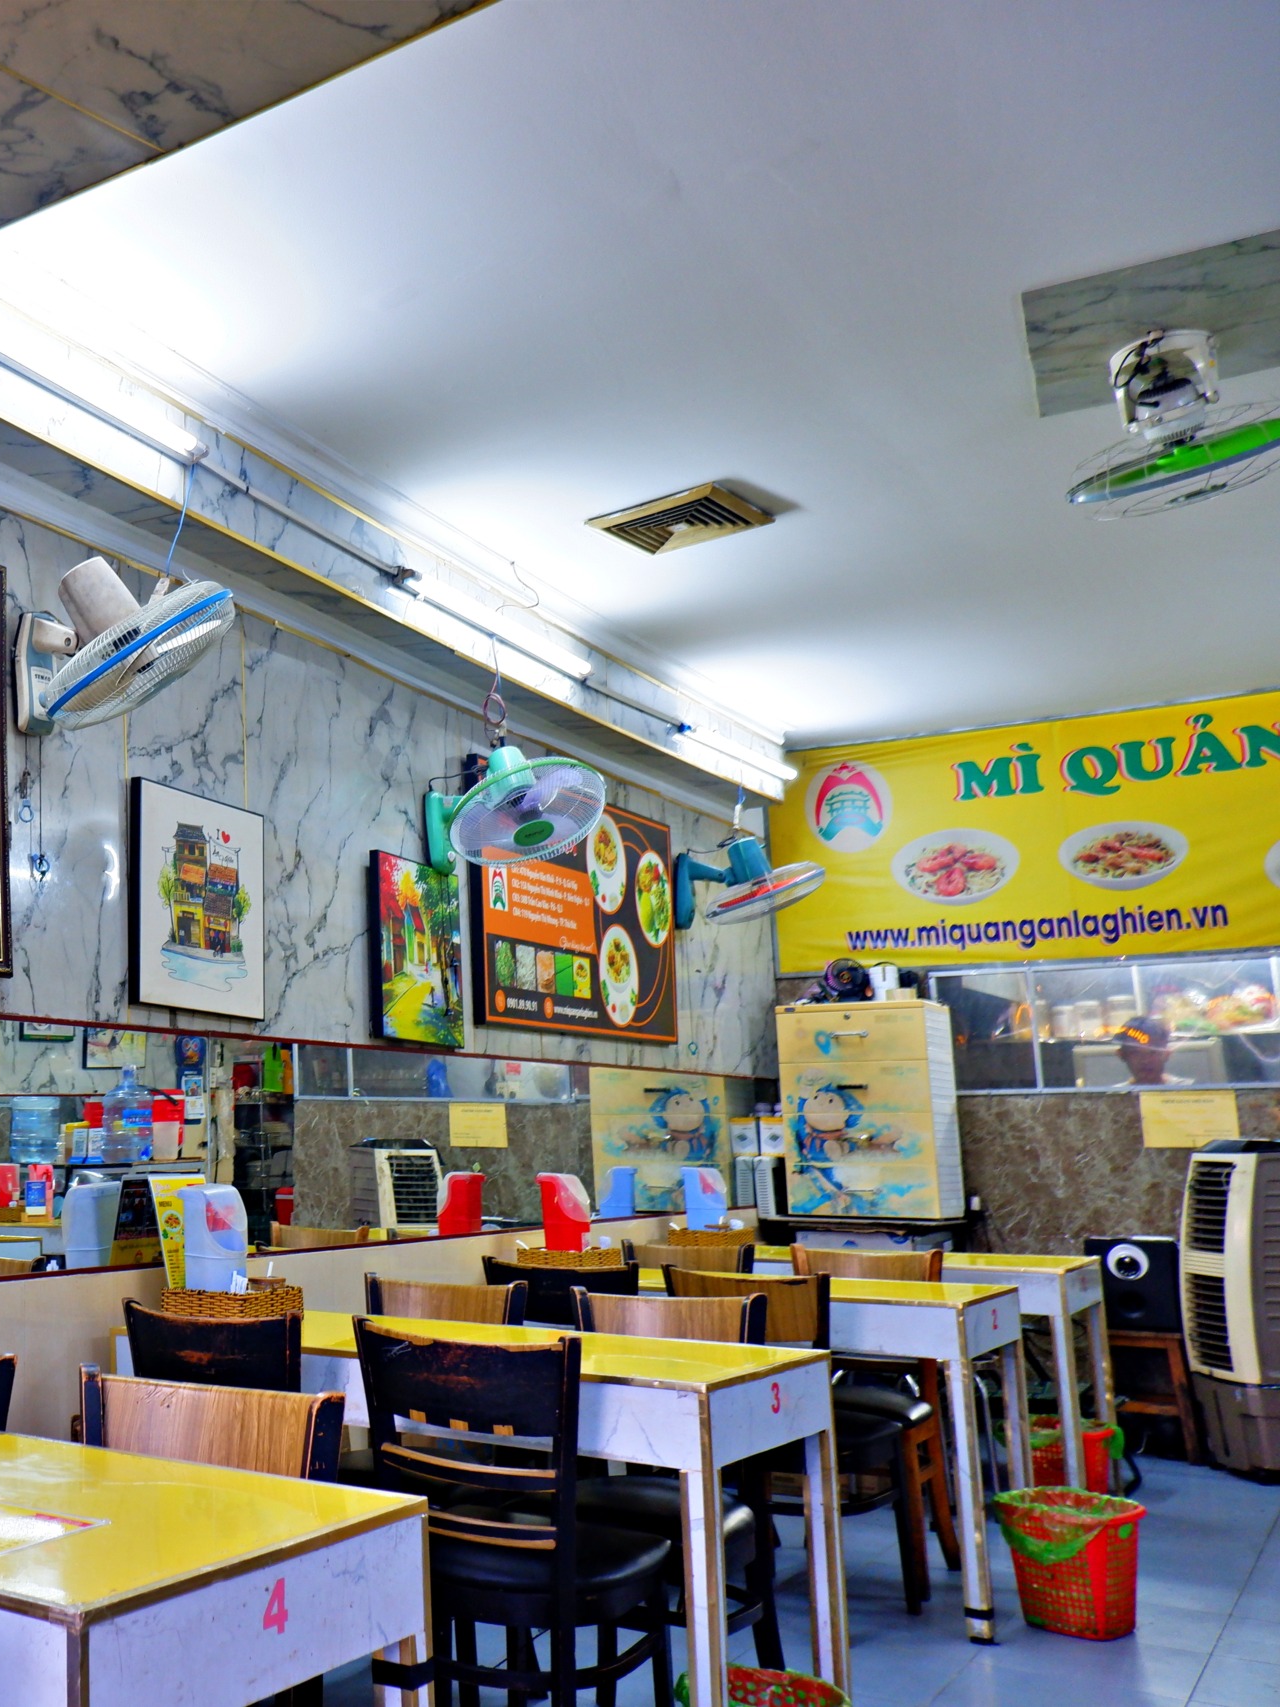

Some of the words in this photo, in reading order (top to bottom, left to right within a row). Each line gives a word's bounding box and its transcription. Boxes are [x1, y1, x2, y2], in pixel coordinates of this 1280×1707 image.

[951, 743, 1044, 801] MÌ
[846, 904, 1228, 951] www.miquanganlaghien.vn
[771, 1382, 781, 1414] 3
[262, 1578, 289, 1634] 4
